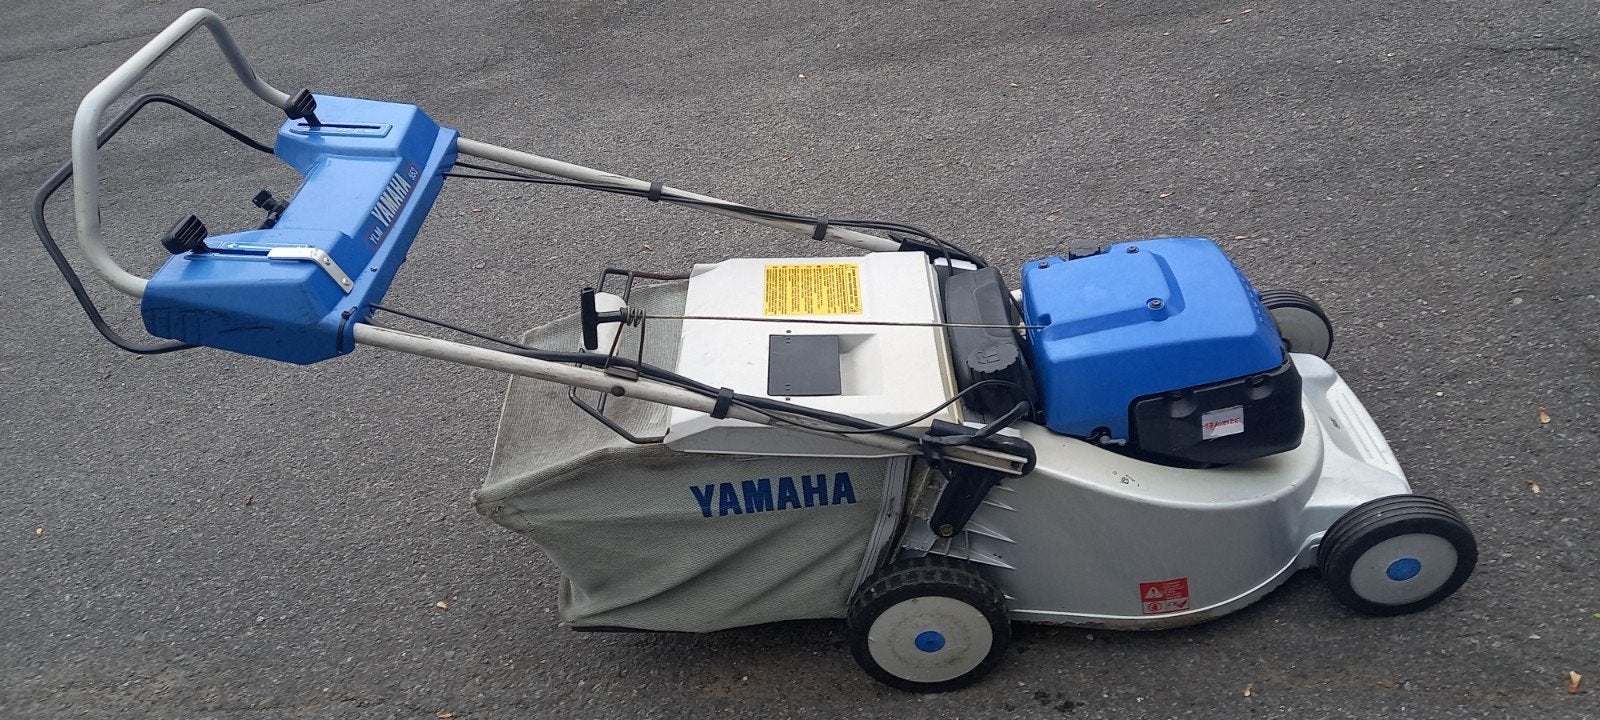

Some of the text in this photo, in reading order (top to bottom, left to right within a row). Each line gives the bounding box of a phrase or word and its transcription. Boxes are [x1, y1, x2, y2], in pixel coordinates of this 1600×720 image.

[370, 172, 412, 228] YAMAHA
[369, 226, 384, 245] YLM
[689, 472, 857, 518] YAMAHA
